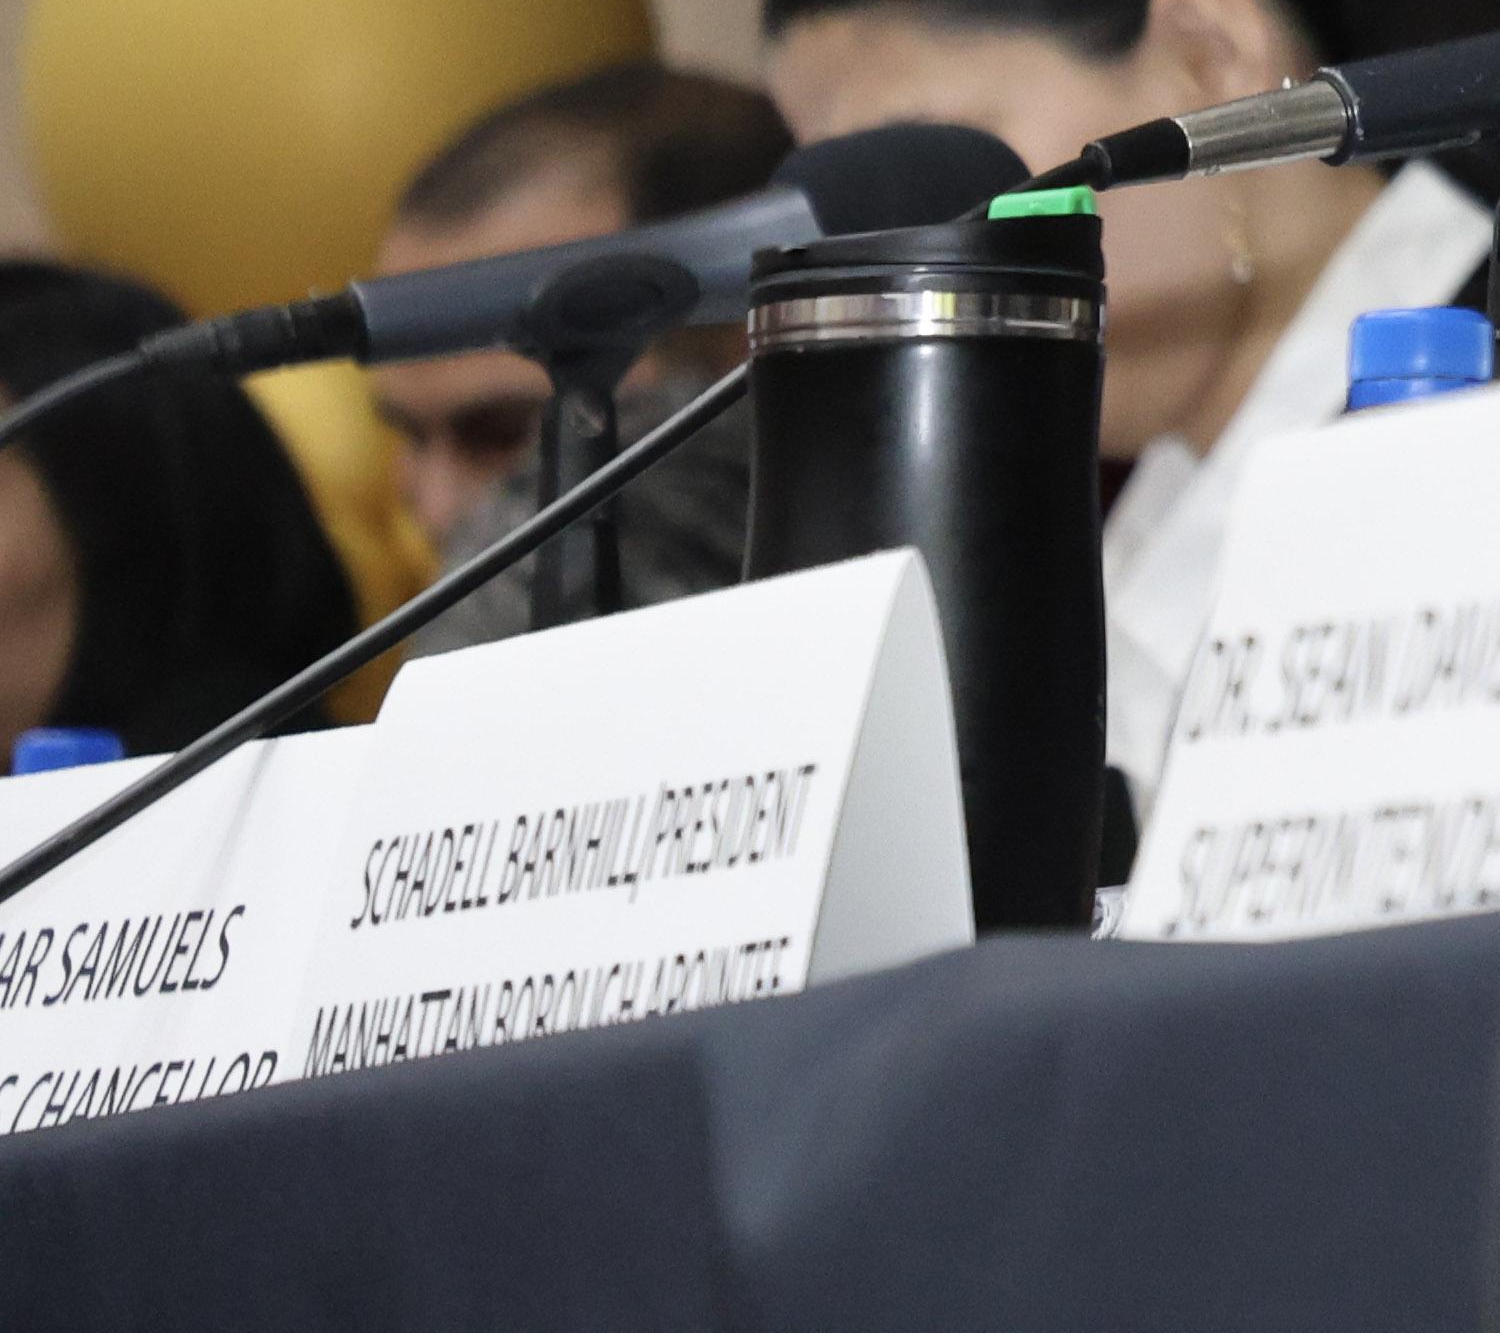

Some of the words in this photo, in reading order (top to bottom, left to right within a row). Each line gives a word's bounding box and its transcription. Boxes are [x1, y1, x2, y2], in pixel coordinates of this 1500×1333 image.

[1264, 617, 1396, 732] SEAN
[350, 821, 500, 930] SCHADELL
[0, 928, 55, 1009] AR
[42, 904, 246, 1007] SAMUELS
[301, 983, 492, 1079] MANHATTAN
[492, 960, 645, 1046] BOROUGH
